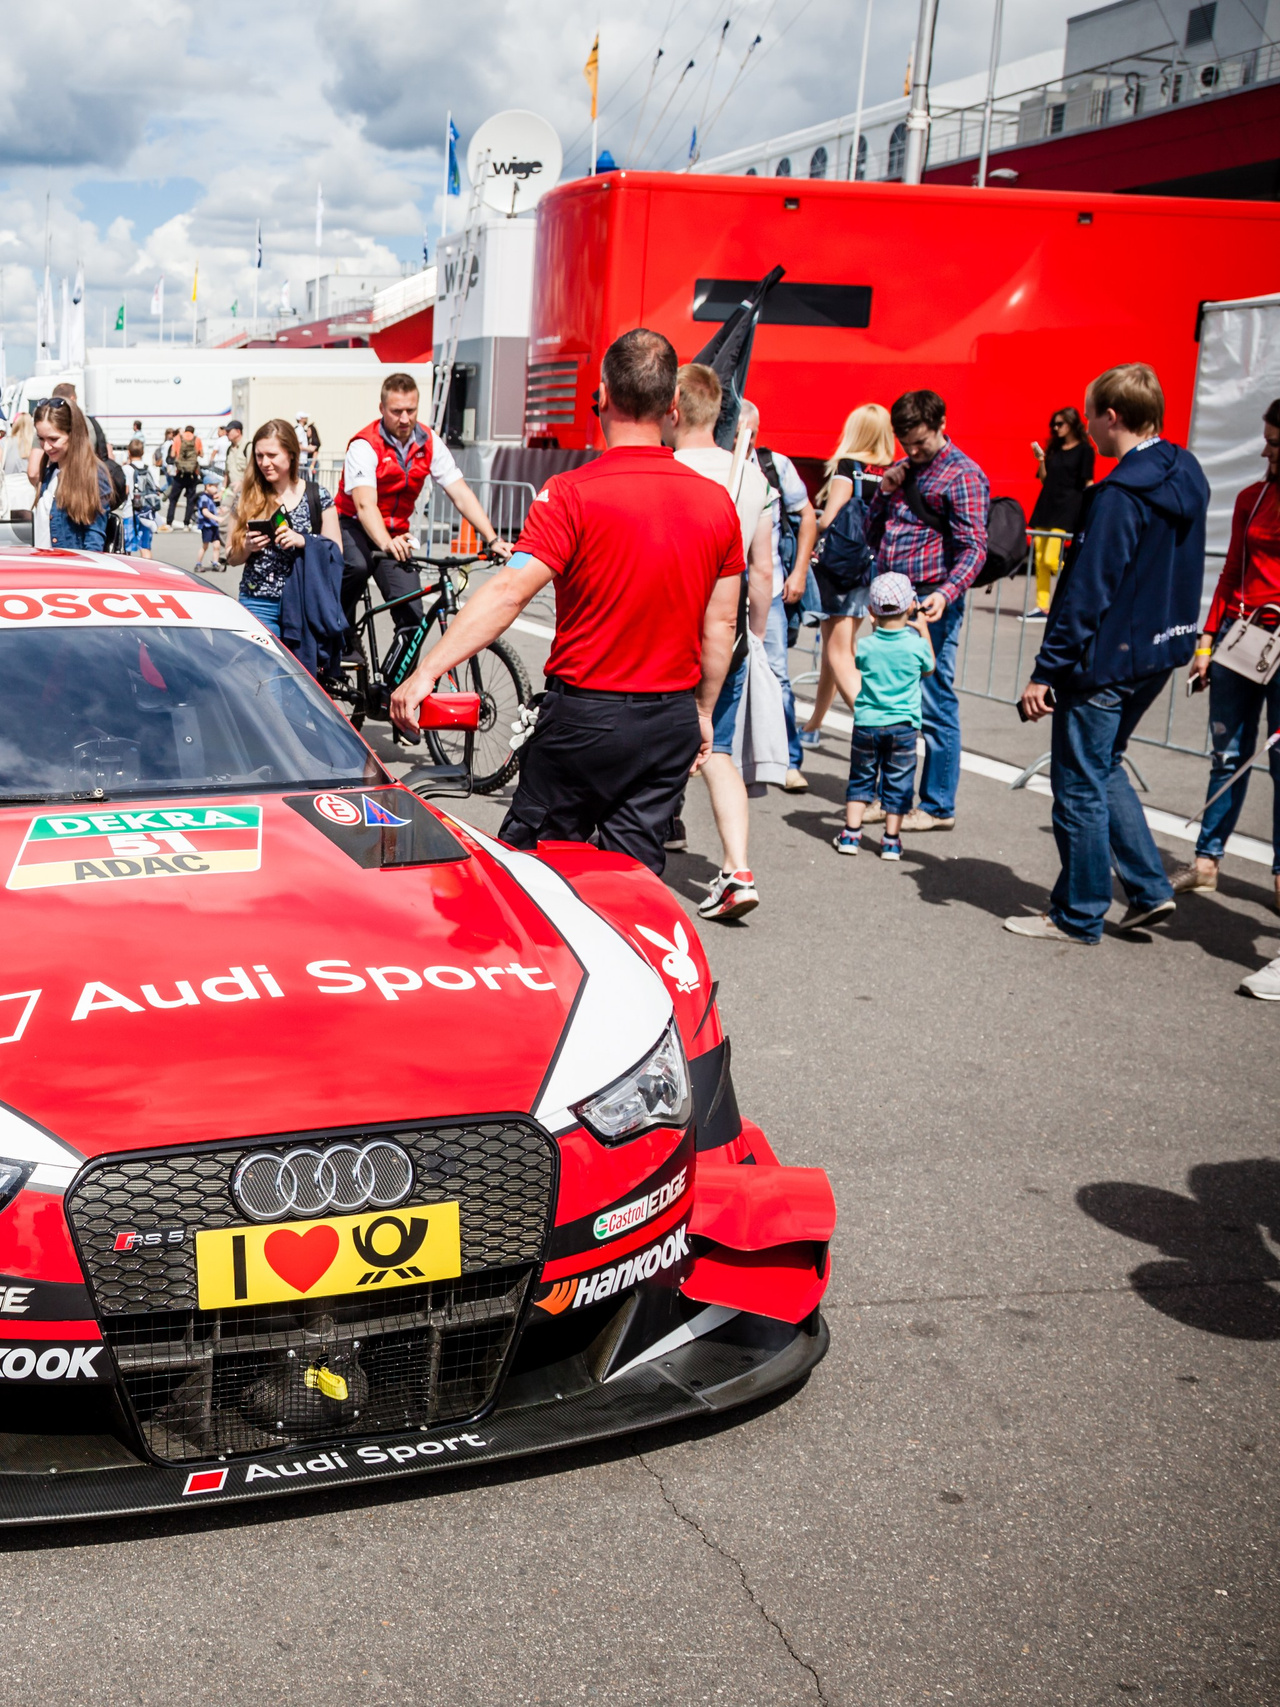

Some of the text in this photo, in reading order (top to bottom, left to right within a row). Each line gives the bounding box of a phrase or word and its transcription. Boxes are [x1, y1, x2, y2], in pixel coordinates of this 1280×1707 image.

[47, 810, 247, 835] DEKRA
[108, 832, 198, 856] 51
[74, 855, 210, 880] ADAC
[71, 959, 557, 1021] Audi Sport
[609, 1166, 687, 1232] Castrol EDGE
[125, 1230, 184, 1247] RS 5
[232, 1235, 248, 1300] I
[245, 1432, 487, 1482] Audi Sport
